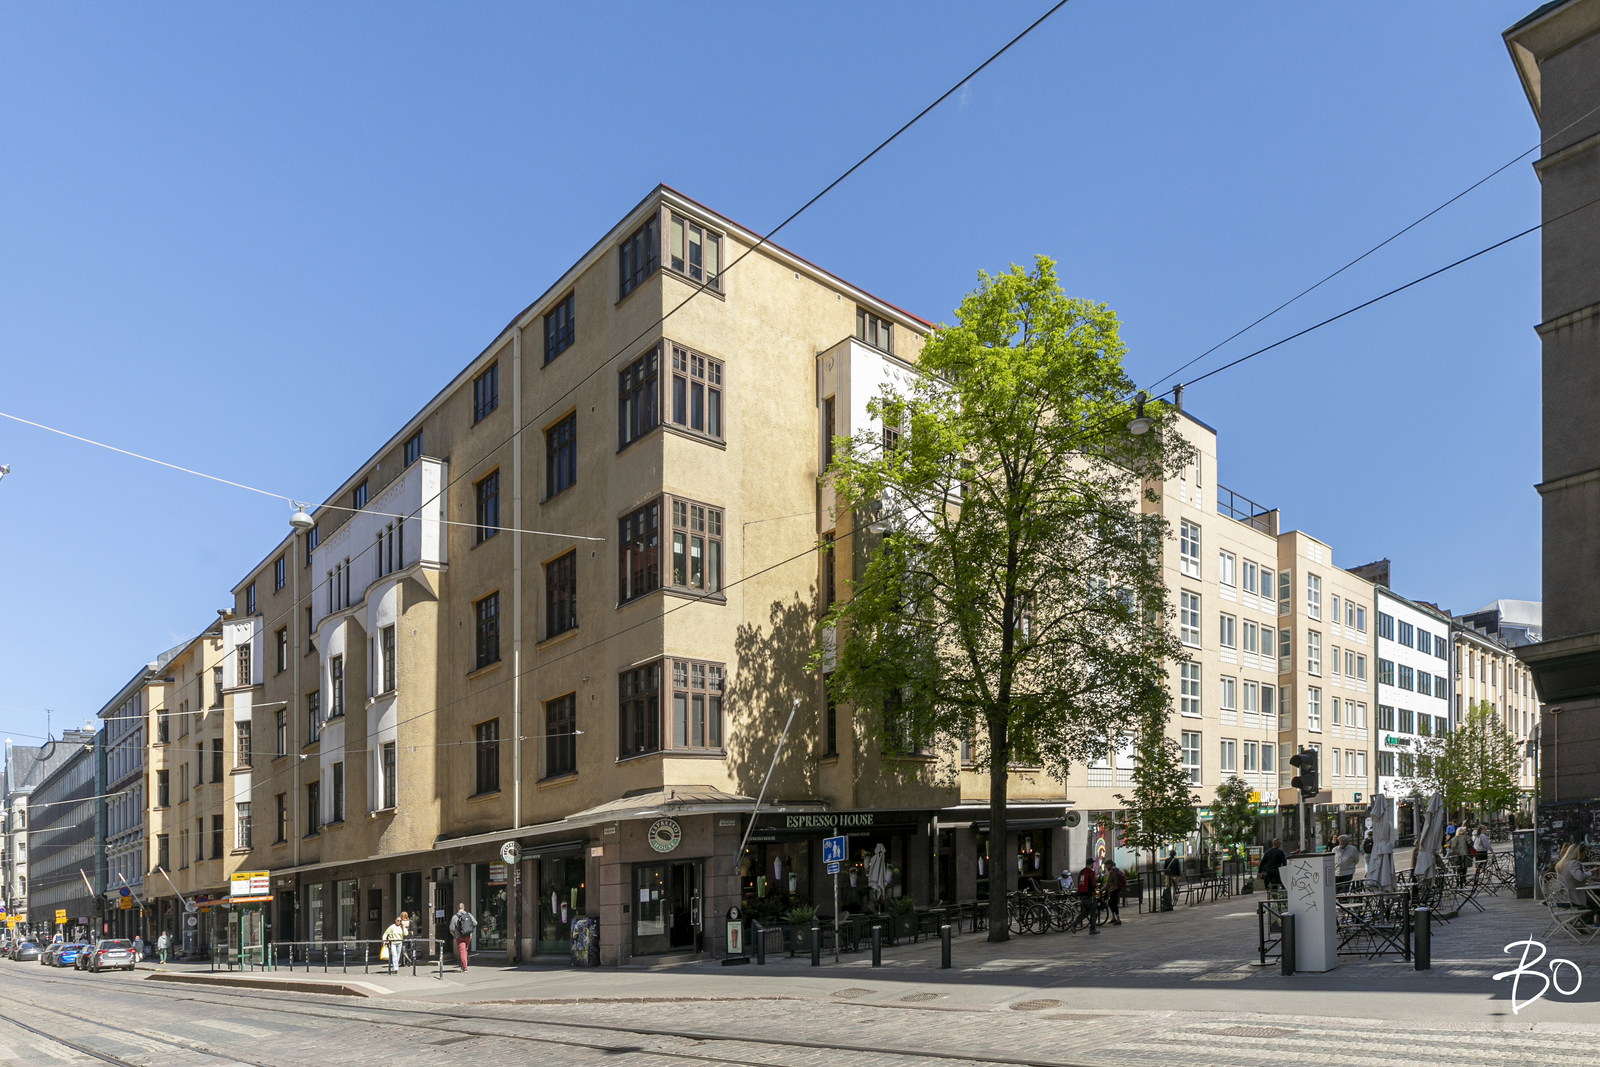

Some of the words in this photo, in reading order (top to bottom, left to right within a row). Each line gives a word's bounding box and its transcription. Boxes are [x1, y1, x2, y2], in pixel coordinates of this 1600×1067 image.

[651, 820, 679, 834] ESPRESSO
[786, 815, 838, 828] ESPRESSO
[840, 814, 874, 826] HOUSE
[653, 841, 675, 851] HOUSE
